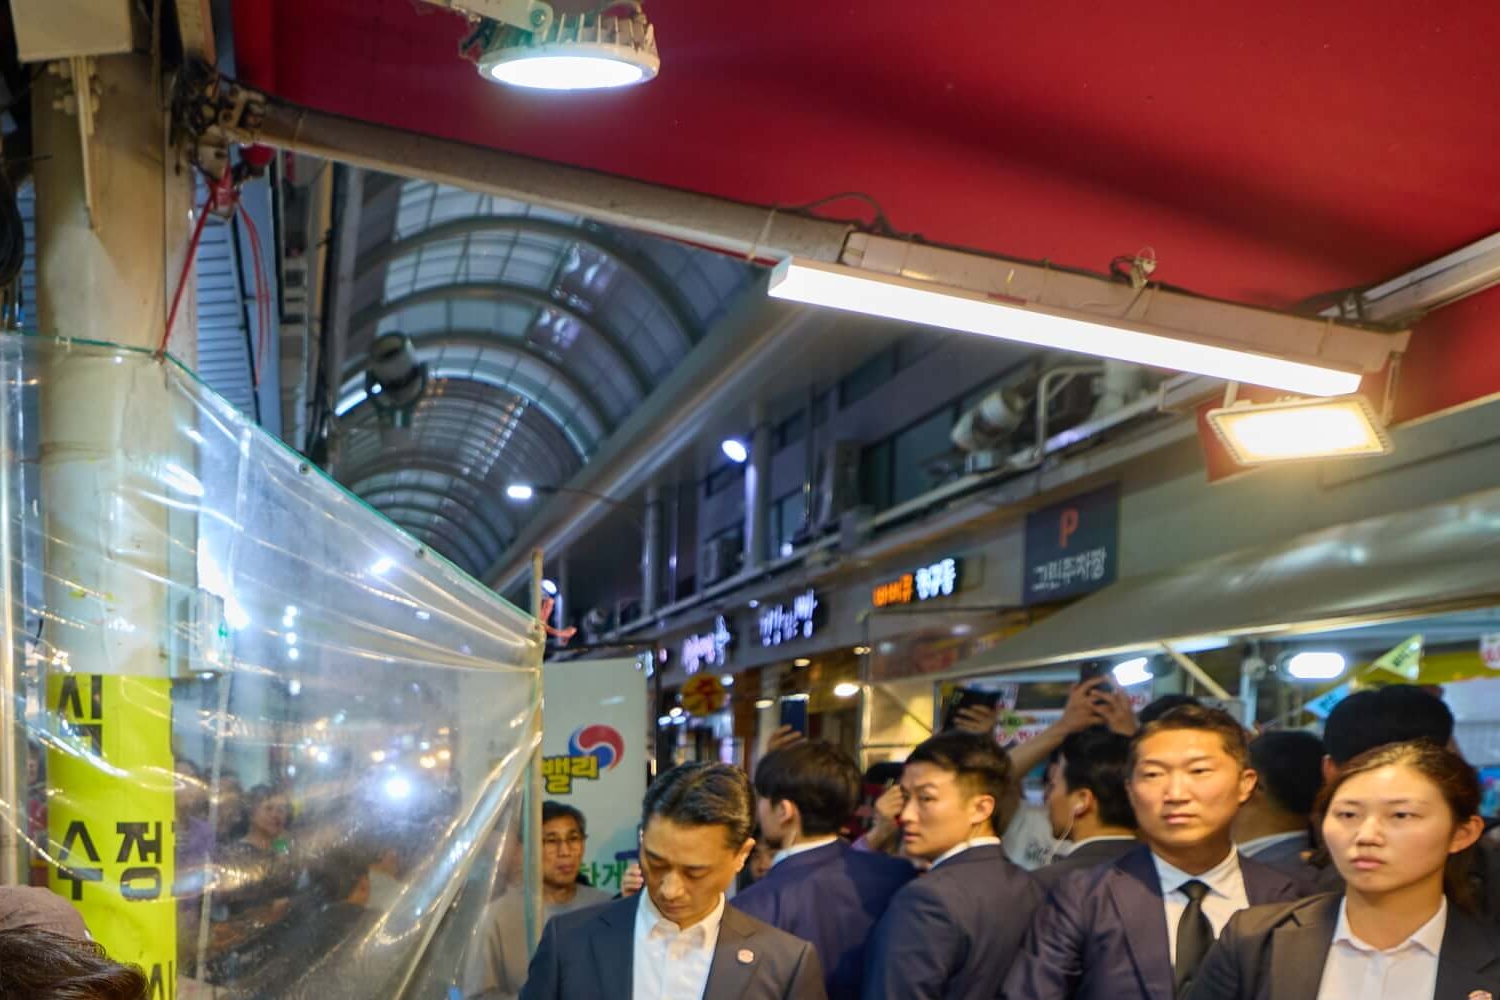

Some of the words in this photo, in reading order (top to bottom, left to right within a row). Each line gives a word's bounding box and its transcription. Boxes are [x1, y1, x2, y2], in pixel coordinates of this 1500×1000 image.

[1059, 508, 1088, 548] P
[1031, 548, 1106, 591] 그린주차장
[57, 820, 178, 902] 수정
